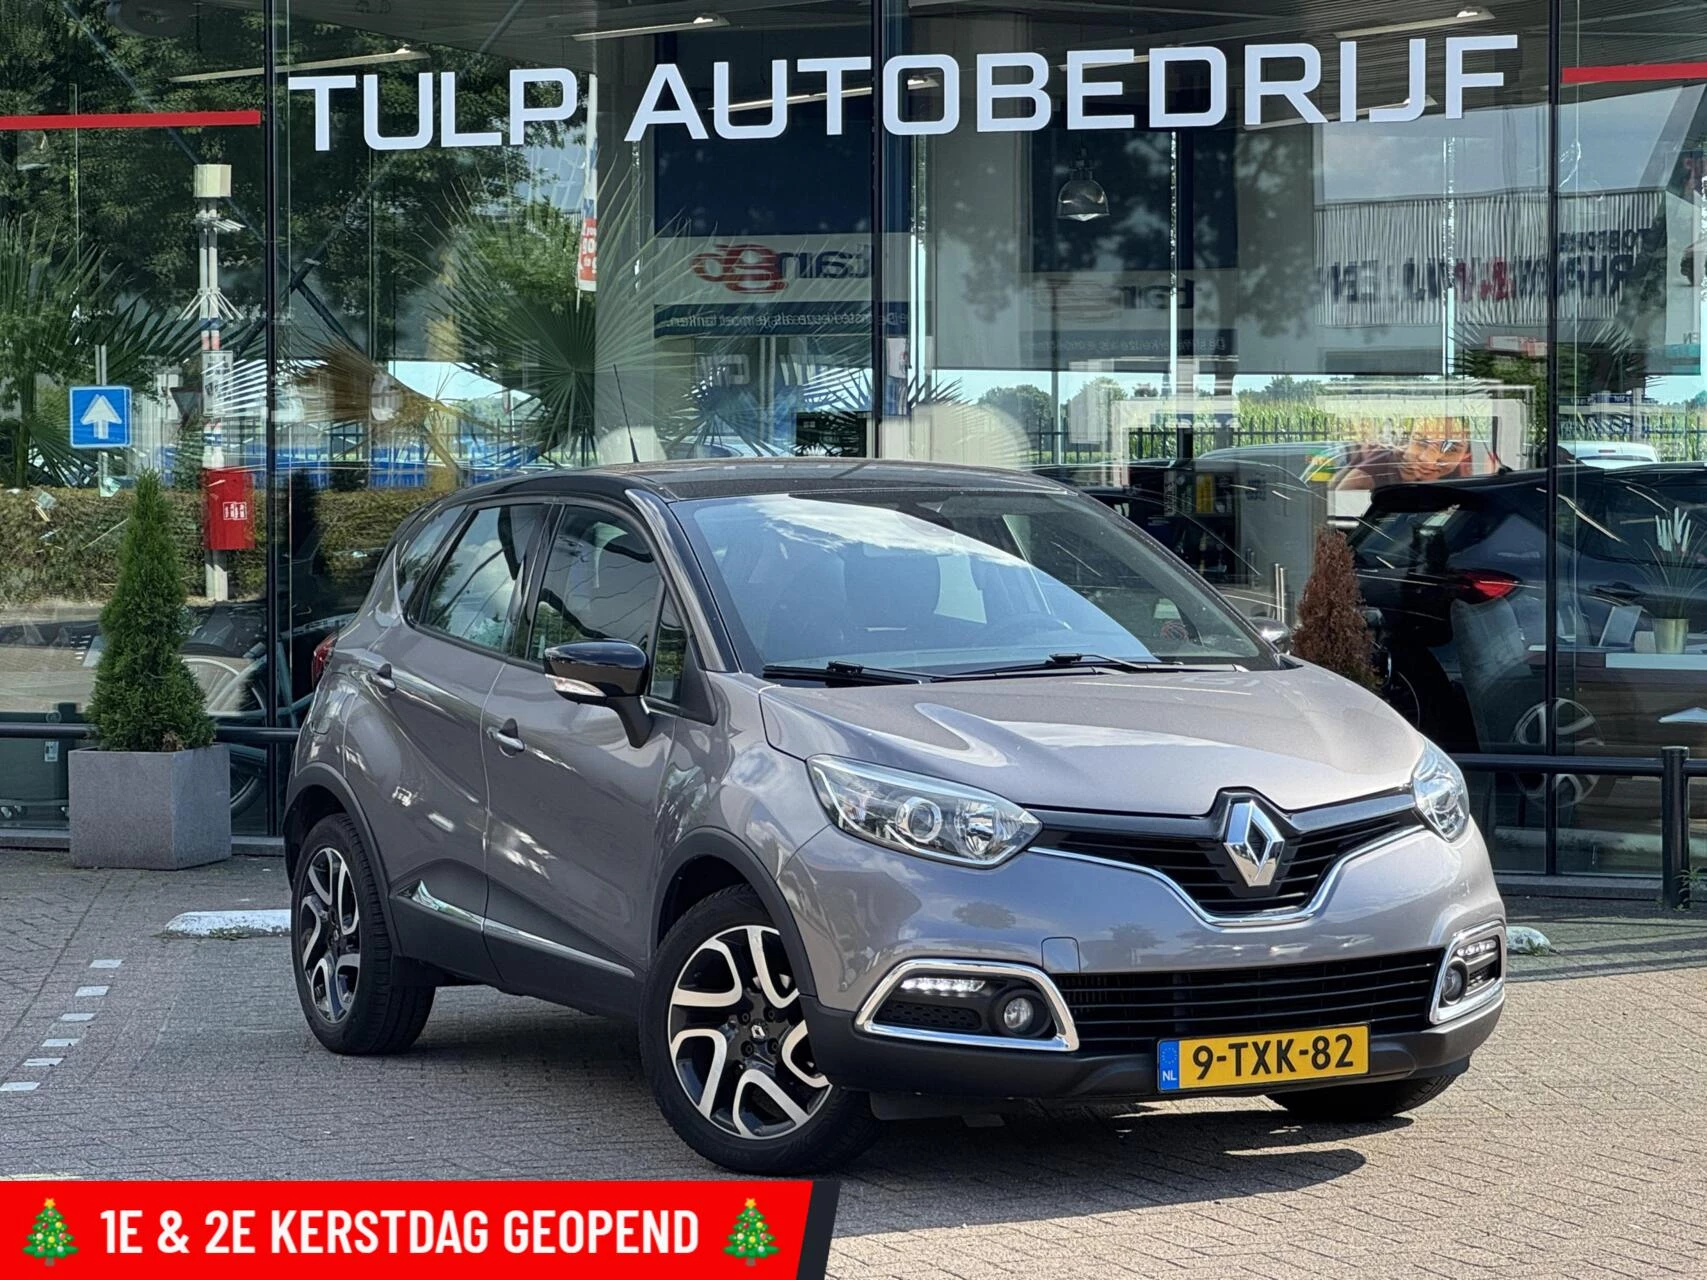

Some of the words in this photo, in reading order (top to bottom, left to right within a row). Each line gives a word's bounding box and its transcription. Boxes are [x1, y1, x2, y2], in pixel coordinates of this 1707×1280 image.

[288, 68, 577, 150] TULP
[625, 35, 1517, 141] AUTOBEDRIJF
[1162, 1071, 1177, 1081] NL
[1192, 1033, 1354, 1080] 9-TXK-82
